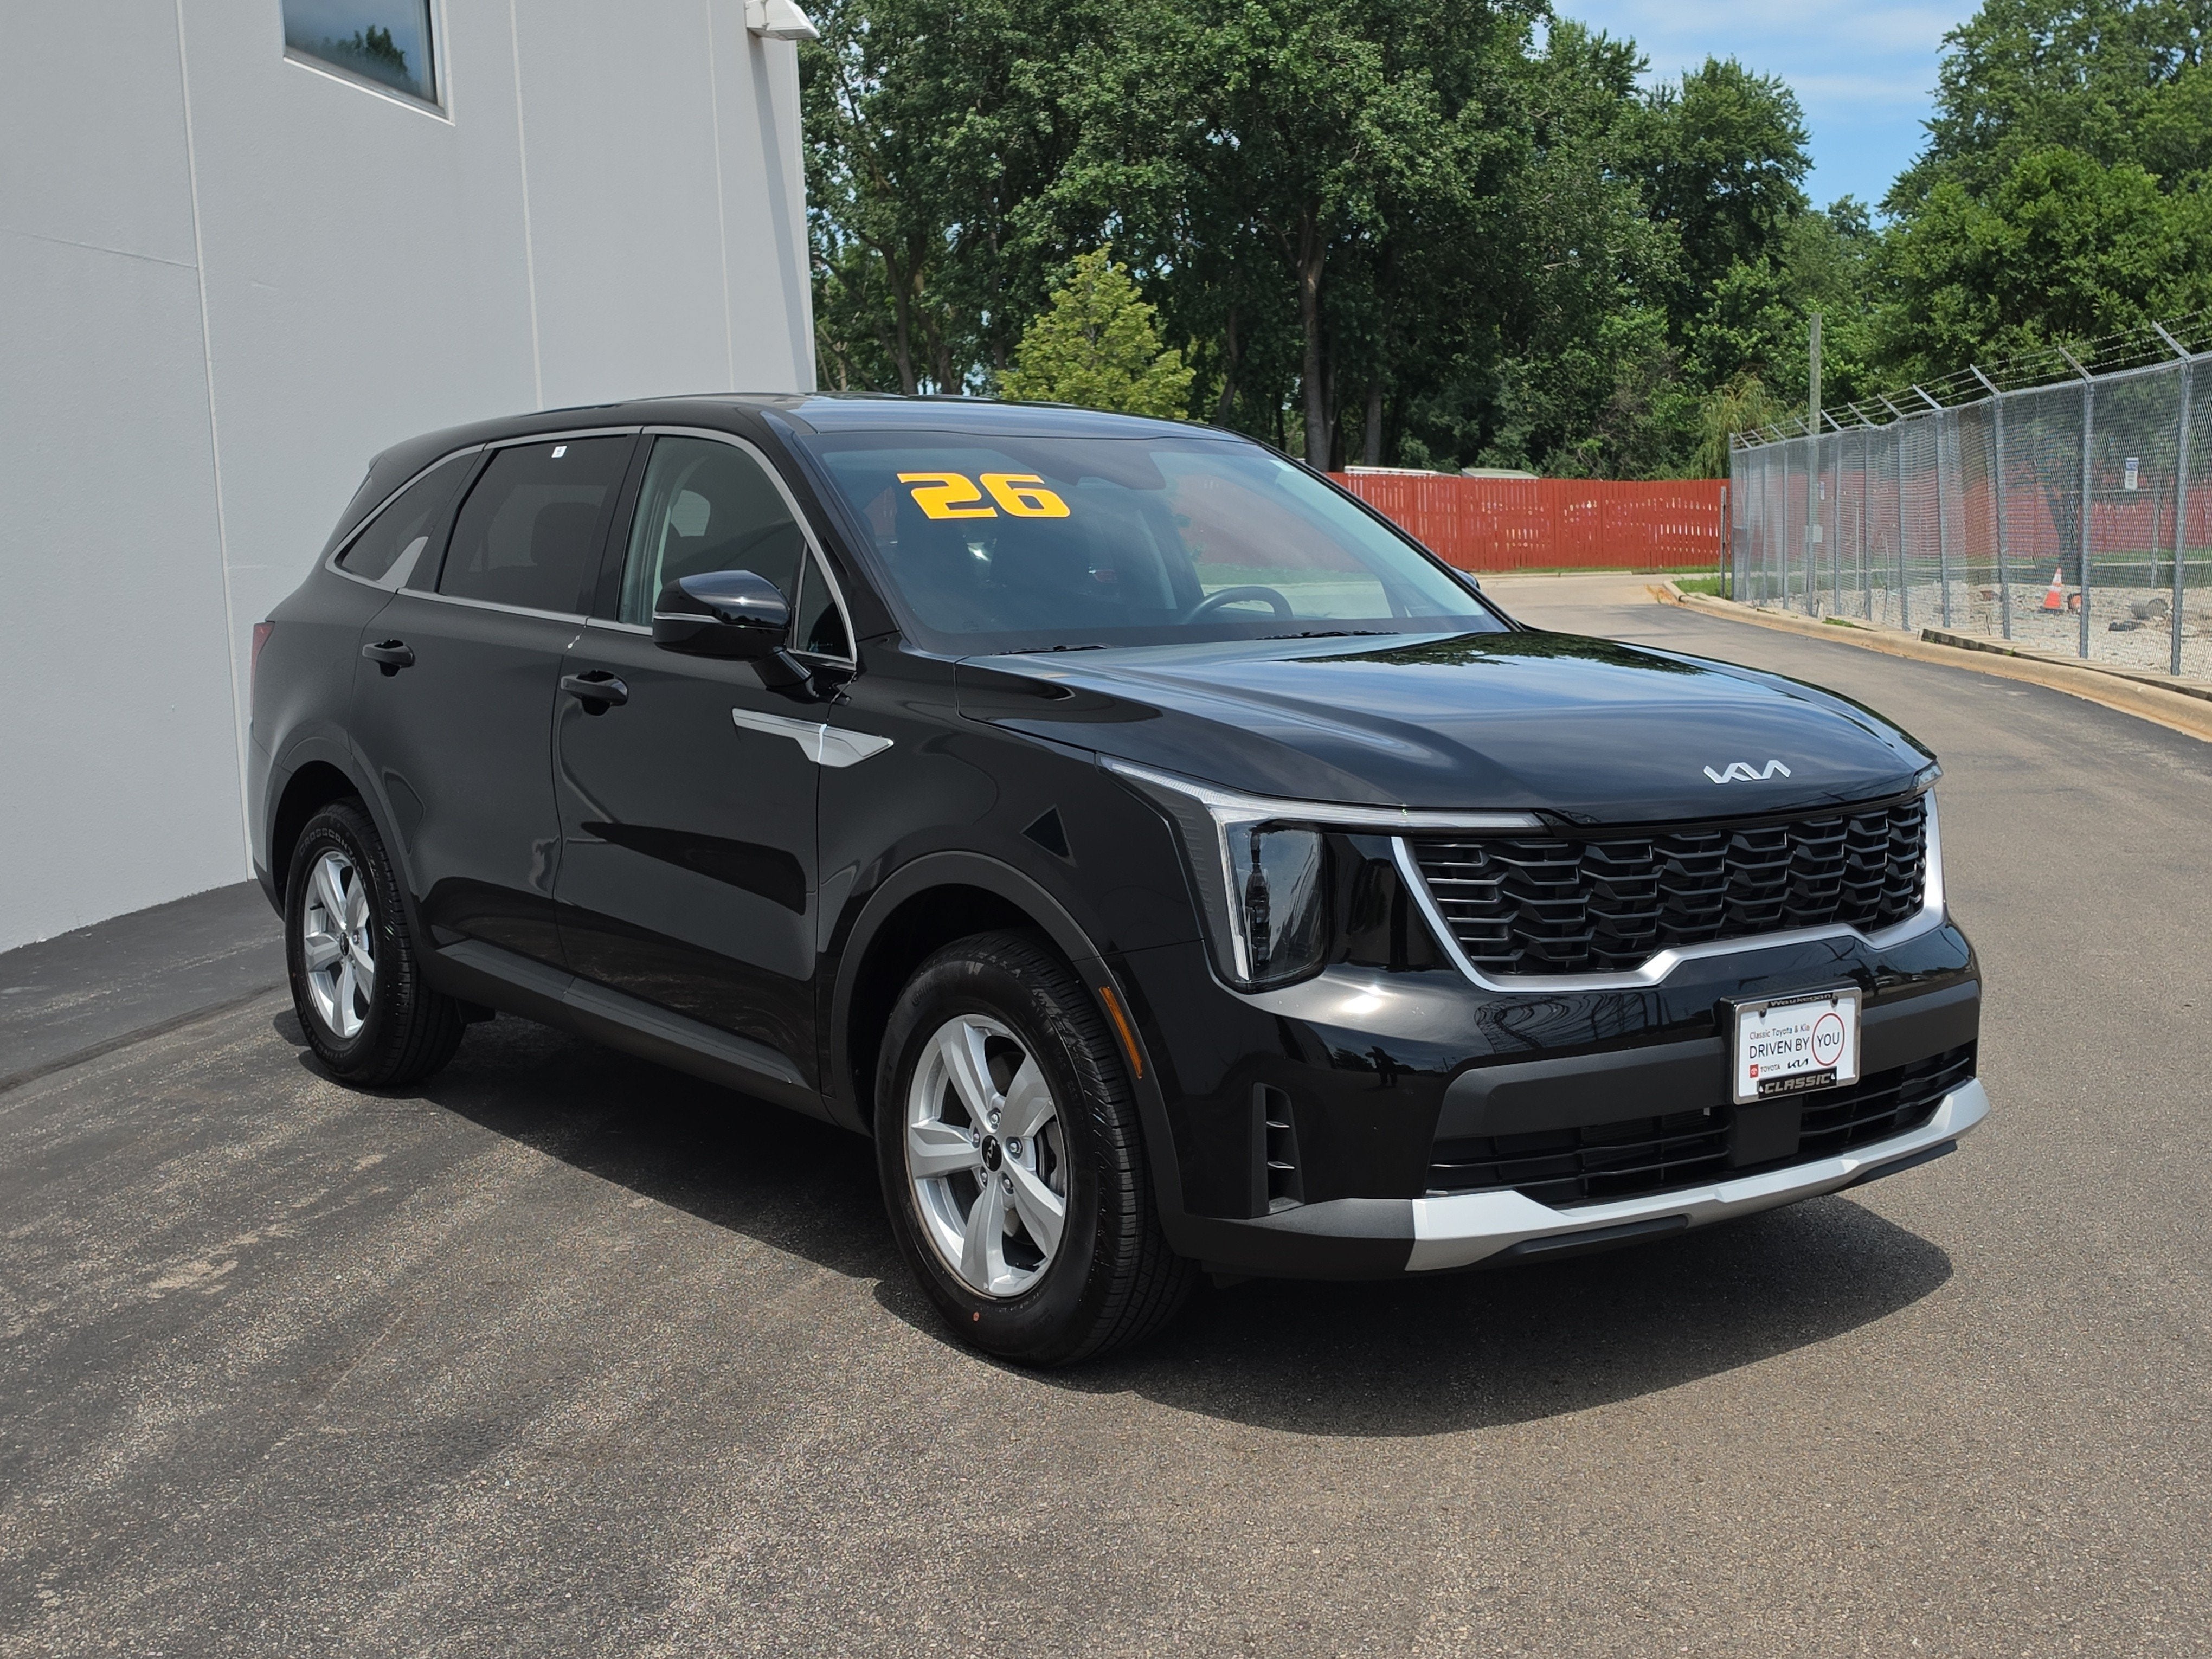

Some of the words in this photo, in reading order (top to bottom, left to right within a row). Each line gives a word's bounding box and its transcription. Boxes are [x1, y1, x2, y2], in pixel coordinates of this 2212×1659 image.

[897, 472, 1071, 519] 26
[1770, 993, 1831, 1007] Waukegan
[1750, 1031, 1770, 1040] Classic
[1772, 1027, 1792, 1037] Toyota
[1794, 1025, 1798, 1033] &
[1801, 1023, 1810, 1032] Kia
[1750, 1039, 1792, 1059] DRIVEN
[1795, 1036, 1810, 1051] BY
[1816, 1031, 1840, 1048] YOU
[1760, 1064, 1781, 1073] TOYOTA
[1764, 1072, 1831, 1094] CLASSIC
